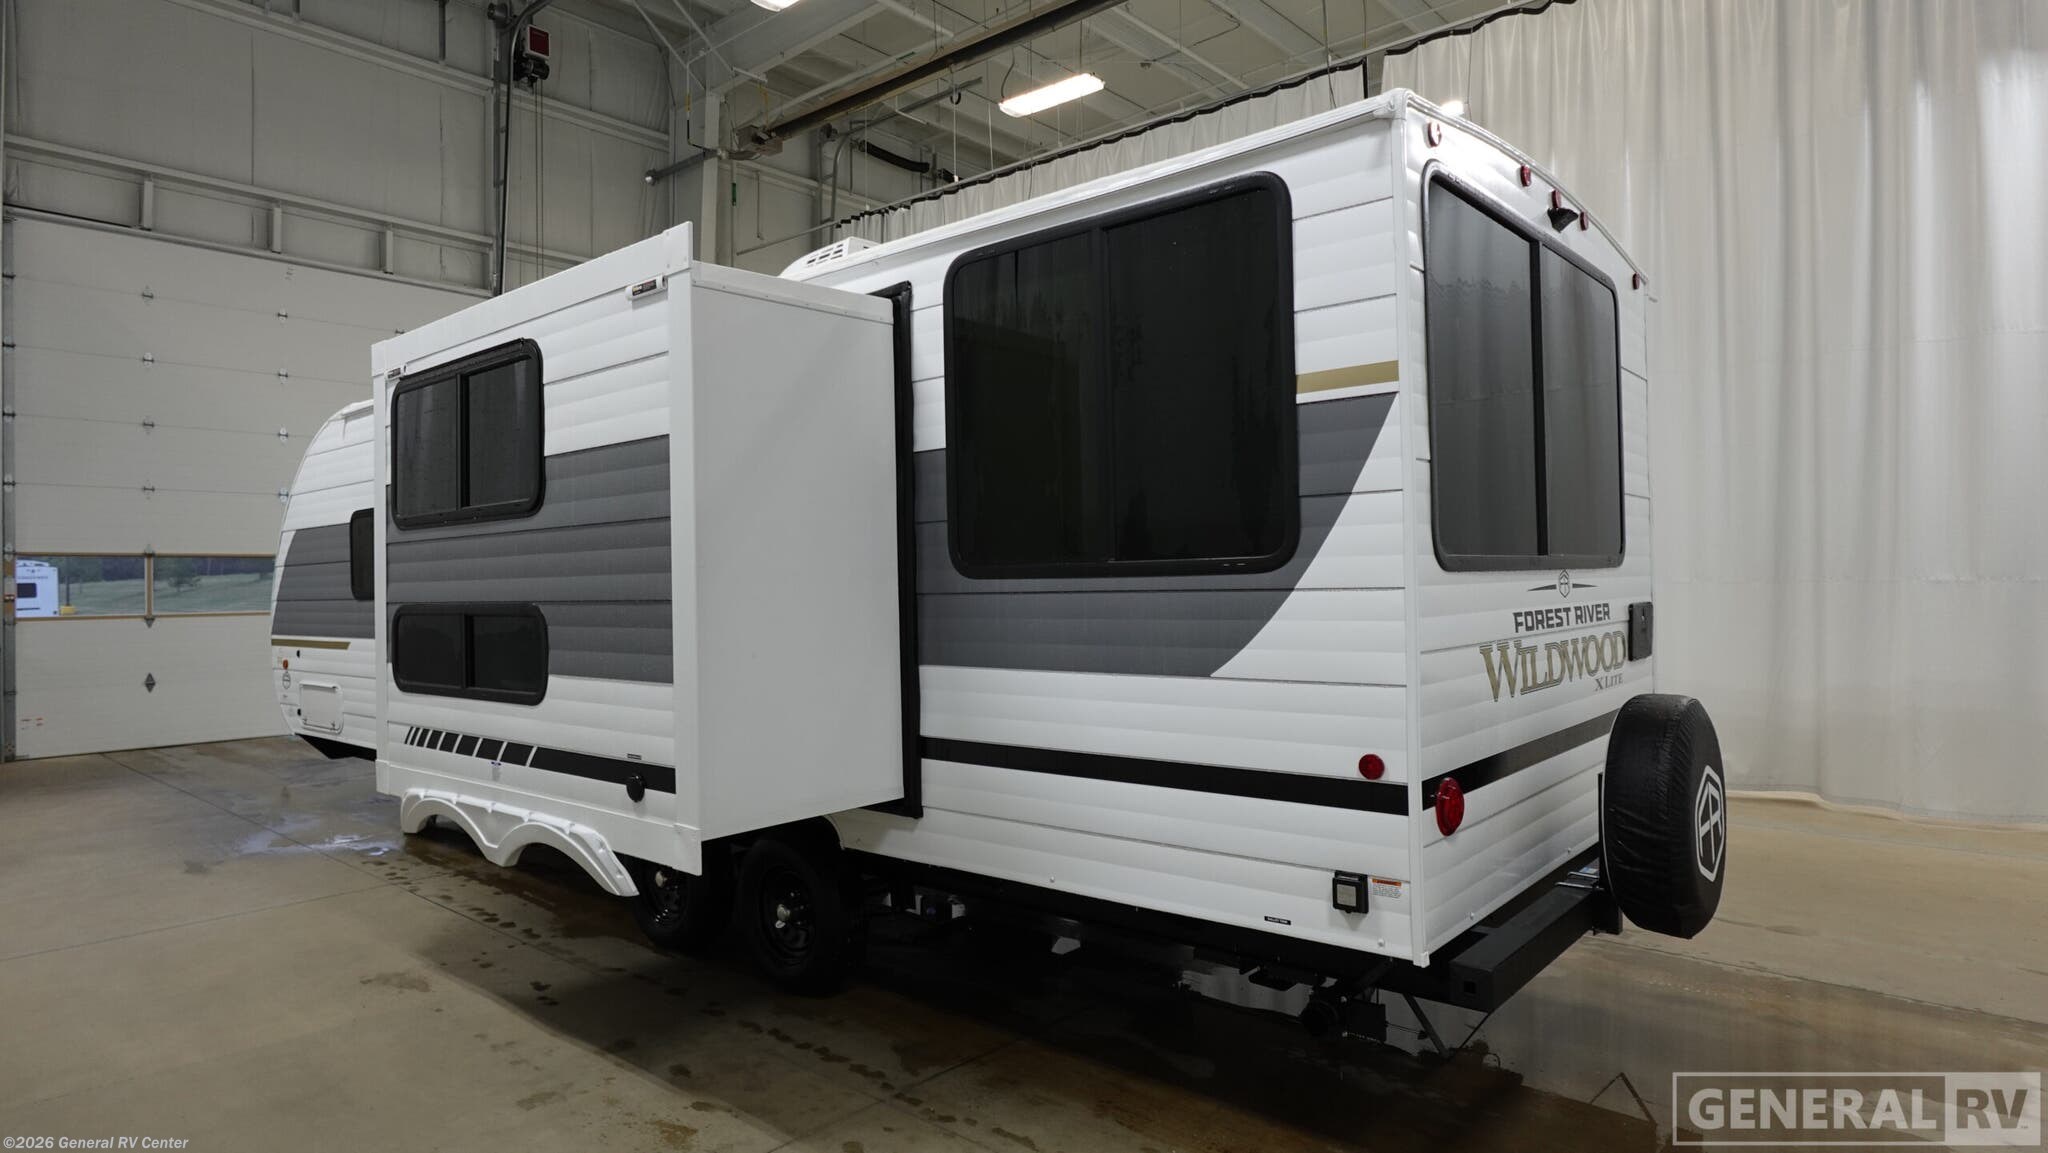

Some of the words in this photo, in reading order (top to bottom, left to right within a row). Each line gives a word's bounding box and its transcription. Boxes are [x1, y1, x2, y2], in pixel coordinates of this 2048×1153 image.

[1513, 606, 1572, 633] FOREST
[1574, 603, 1611, 625] RIVER
[1479, 630, 1627, 702] WILDWOOD
